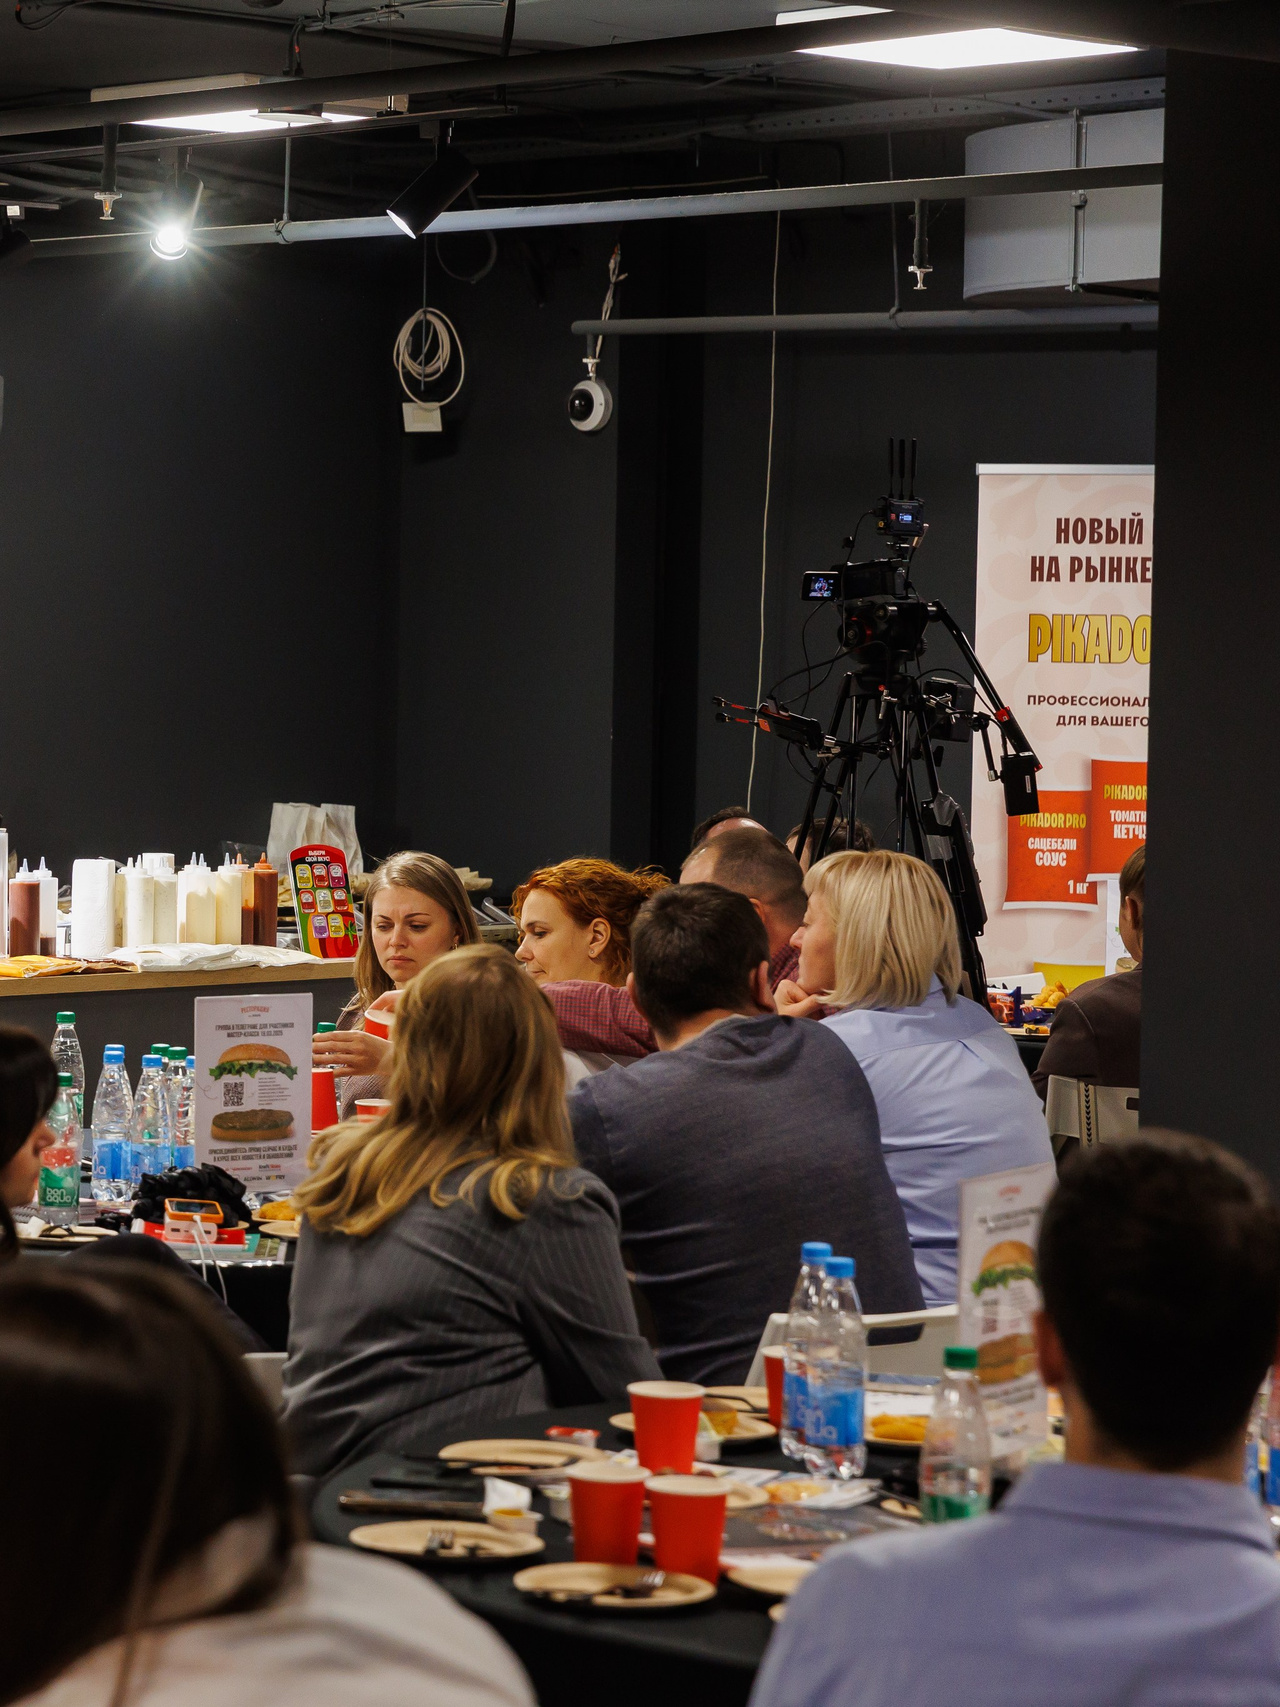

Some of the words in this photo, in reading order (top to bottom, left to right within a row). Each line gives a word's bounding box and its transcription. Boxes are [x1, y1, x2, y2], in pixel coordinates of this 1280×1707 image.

[1056, 512, 1144, 545] НОВЫЙ
[1030, 556, 1061, 582] НА
[1069, 556, 1152, 583] РЫНКЕ
[1027, 613, 1151, 665] PIKADO
[1056, 715, 1087, 727] ДЛЯ
[1091, 716, 1149, 727] ВАШЕГО
[1019, 812, 1064, 828] PIKADOR
[1065, 813, 1087, 829] PRO
[1028, 837, 1077, 851] САЦЕБЕЛИ
[1035, 851, 1067, 867] СОУС
[1067, 880, 1073, 894] 1
[1076, 882, 1089, 894] кг
[46, 1187, 66, 1196] bon
[46, 1194, 71, 1203] aqua
